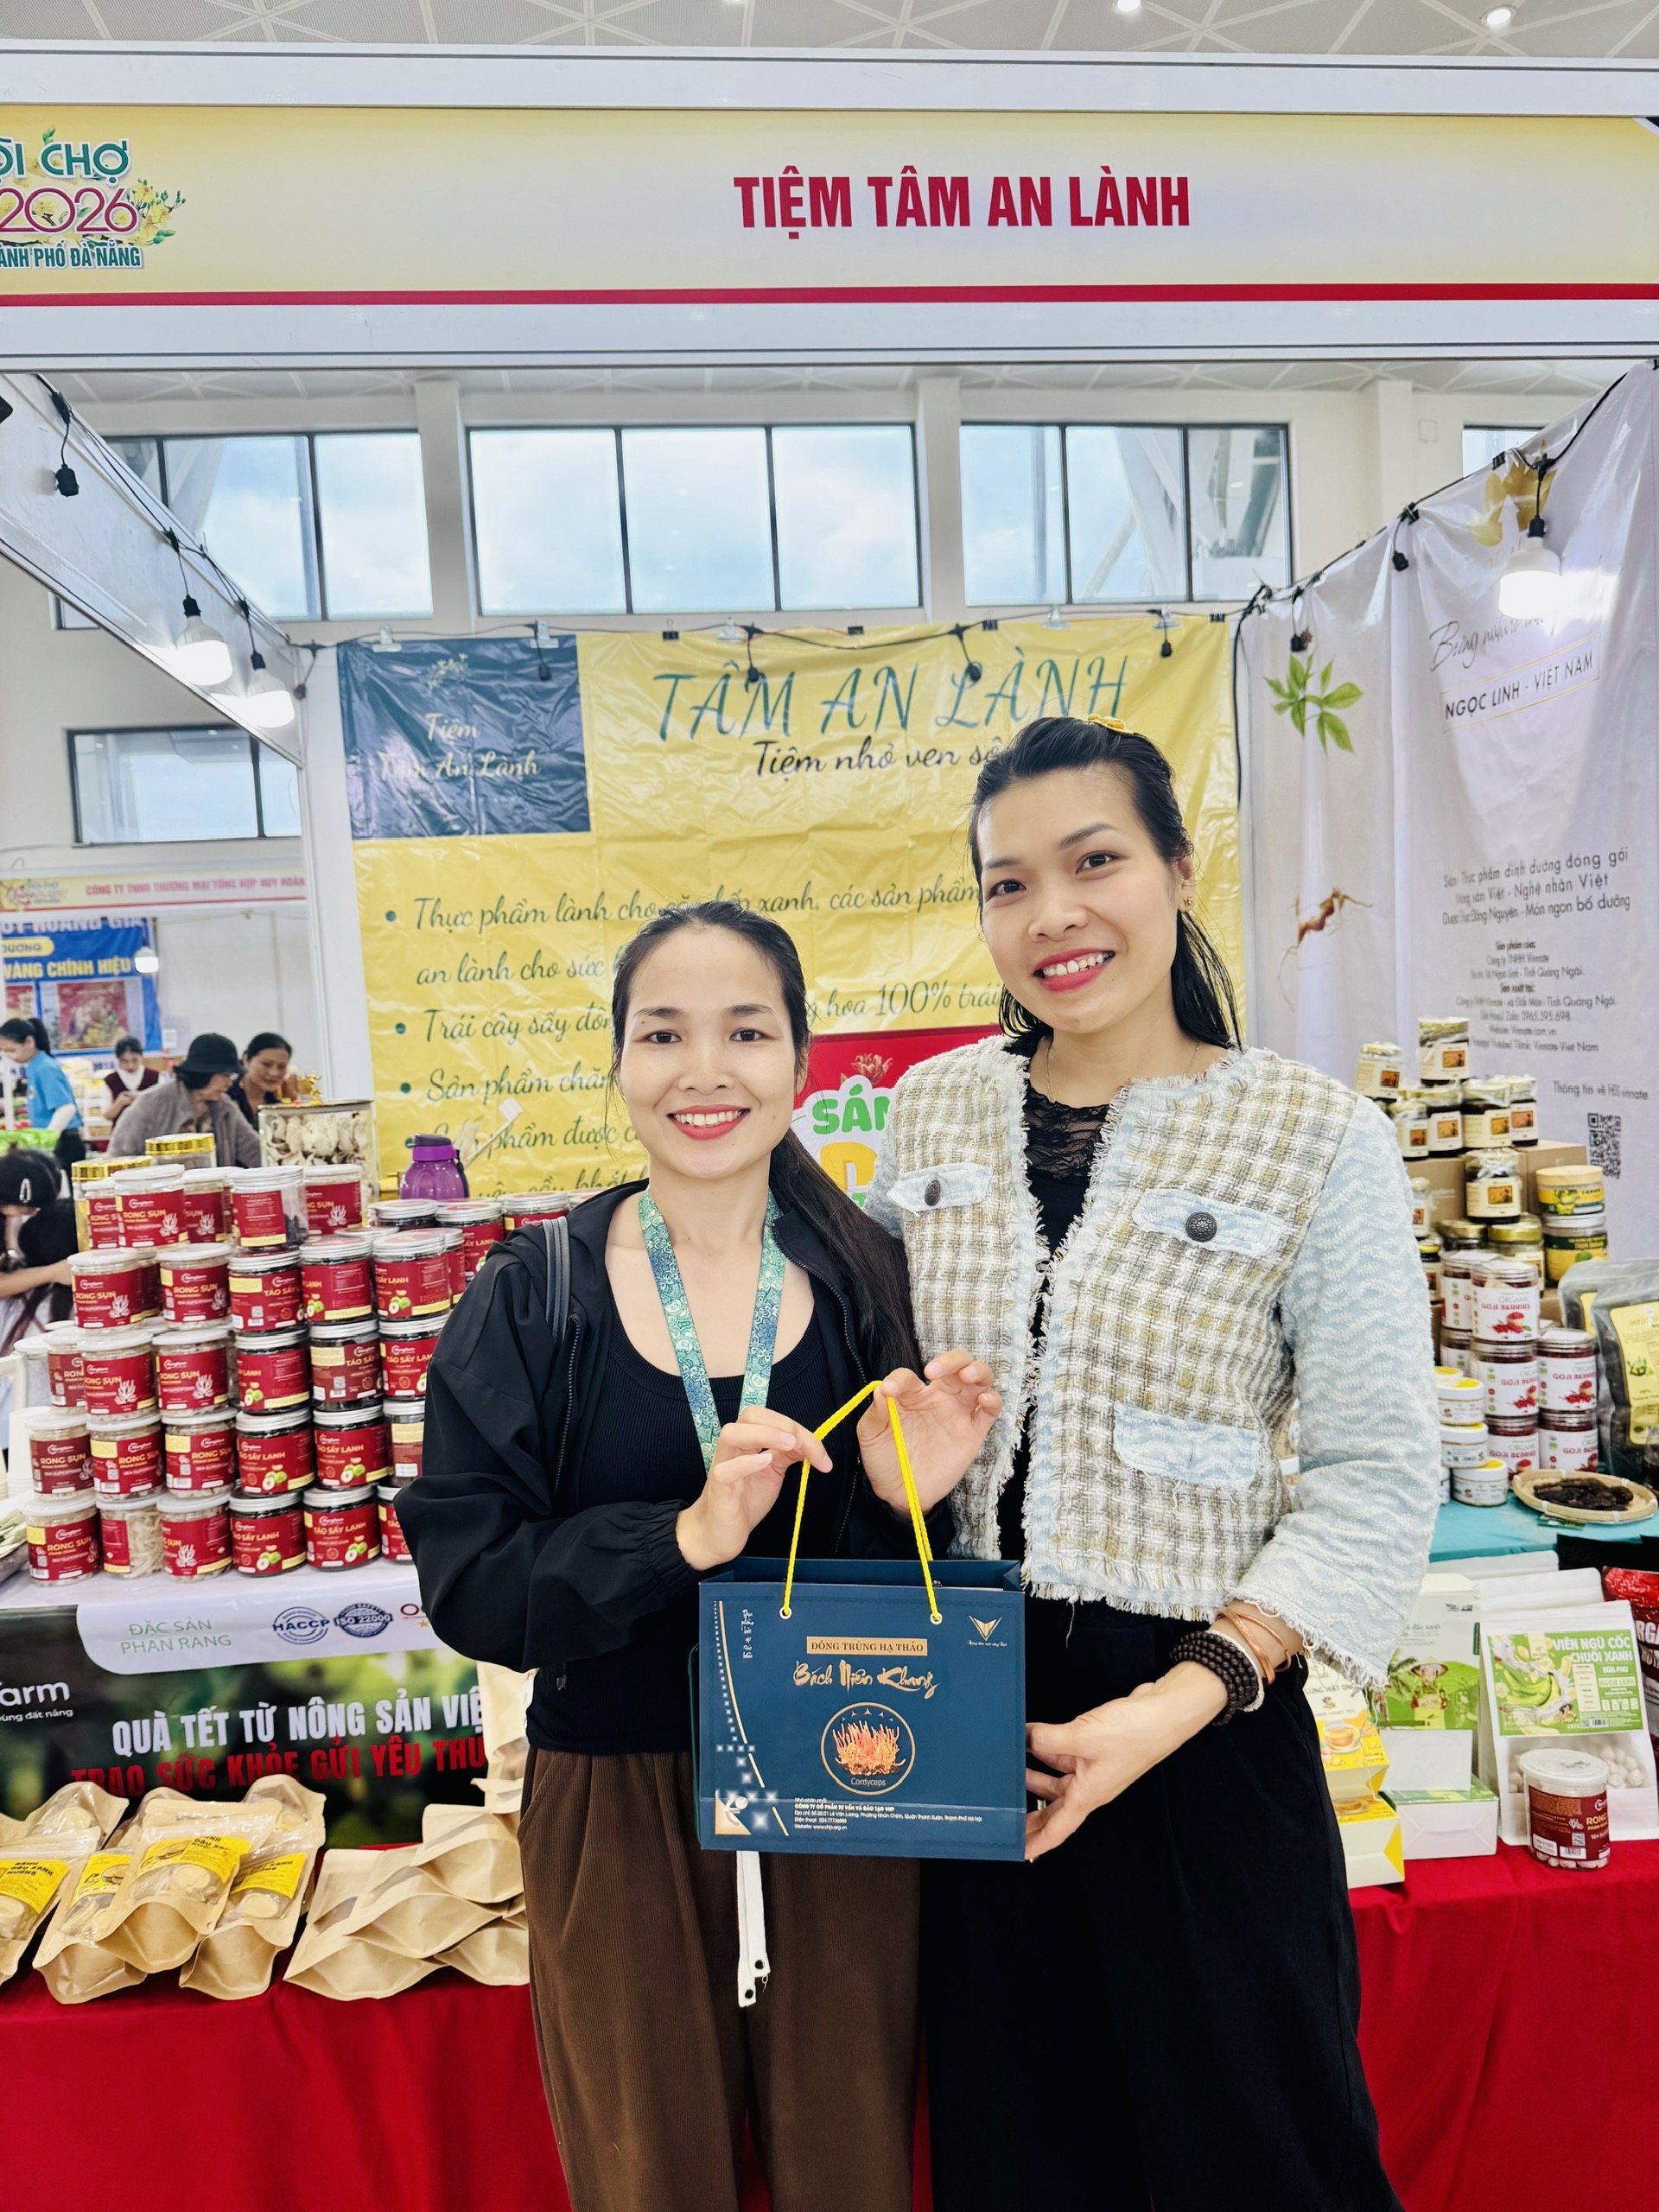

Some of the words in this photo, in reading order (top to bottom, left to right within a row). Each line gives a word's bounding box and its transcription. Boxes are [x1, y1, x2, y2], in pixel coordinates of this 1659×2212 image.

[41, 140, 130, 183] CHỢ
[0, 188, 137, 232] 2026
[734, 165, 852, 239] TIỆM
[868, 165, 970, 226] TÂM
[988, 176, 1052, 226] AN
[1069, 165, 1190, 226] LÀNH
[34, 240, 66, 267] PHỐ
[70, 243, 92, 267] ĐÀ
[96, 239, 141, 267] NẴNG
[653, 660, 796, 741] TÂM
[821, 664, 919, 734] AN
[935, 646, 1128, 729] LÀNH
[1445, 694, 1487, 719] NGỌC
[1491, 682, 1520, 707] LINH
[1535, 664, 1560, 691] VIỆT
[1564, 651, 1592, 679] NAM
[435, 752, 468, 778] An
[476, 749, 542, 779] Lành
[753, 740, 827, 782] Tiệm
[836, 735, 896, 771] nhỏ
[906, 750, 961, 769] ven
[1567, 851, 1600, 869] đóng
[1609, 847, 1628, 868] gói
[1579, 873, 1608, 891] Việt
[414, 897, 473, 933] Thực
[479, 894, 550, 935] phẩm
[555, 892, 610, 923] lành
[830, 884, 864, 910] các
[870, 883, 913, 908] sản
[3, 958, 42, 980] VÀNG
[47, 957, 94, 977] CHÍNH
[98, 954, 132, 976] HIỆU
[416, 969, 450, 985] an
[457, 951, 514, 983] lành
[520, 949, 560, 980] cho
[422, 1008, 475, 1043] Trái
[481, 1012, 524, 1046] cây
[529, 1008, 570, 1043] sấy
[821, 987, 868, 1018] hoa
[875, 980, 951, 1017] 100%
[426, 1067, 475, 1103] Sản
[483, 1065, 553, 1105] phẩm
[559, 1060, 607, 1093] chă
[563, 1115, 617, 1150] được
[41, 1456, 66, 1465] RONG
[47, 1542, 74, 1552] RONG
[128, 1621, 169, 1637] ĐẶC
[173, 1617, 212, 1633] SẢN
[272, 1618, 330, 1632] HACCP
[334, 1617, 354, 1626] ISO
[359, 1614, 391, 1624] 22000
[121, 1636, 174, 1655] PHAN
[178, 1634, 232, 1650] RANG
[811, 1640, 839, 1650] ĐÔNG
[842, 1640, 876, 1651] TRÙNG
[880, 1643, 893, 1653] HẠ
[896, 1641, 924, 1652] THẢO
[1553, 1636, 1580, 1650] VIÊN
[1580, 1635, 1605, 1649] NGŨ
[1608, 1633, 1631, 1649] CỐC
[1570, 1649, 1603, 1662] CHUỐI
[1605, 1650, 1633, 1662] XANH
[0, 1681, 70, 1707] arm
[793, 1660, 833, 1686] Bách
[876, 1665, 941, 1700] Khang
[25, 1710, 44, 1719] đất
[111, 1709, 172, 1758] QUÀ
[180, 1705, 229, 1749] TẾT
[239, 1701, 276, 1744] TỪ
[289, 1695, 365, 1741] NÔNG
[375, 1687, 432, 1735] SẢN
[441, 1685, 483, 1734] VIỆ
[156, 1751, 216, 1793] SỨC
[226, 1741, 300, 1788] KHỎE
[310, 1734, 360, 1782] GỬI
[370, 1734, 423, 1777] YÊU
[850, 1777, 887, 1788] Cordyceps
